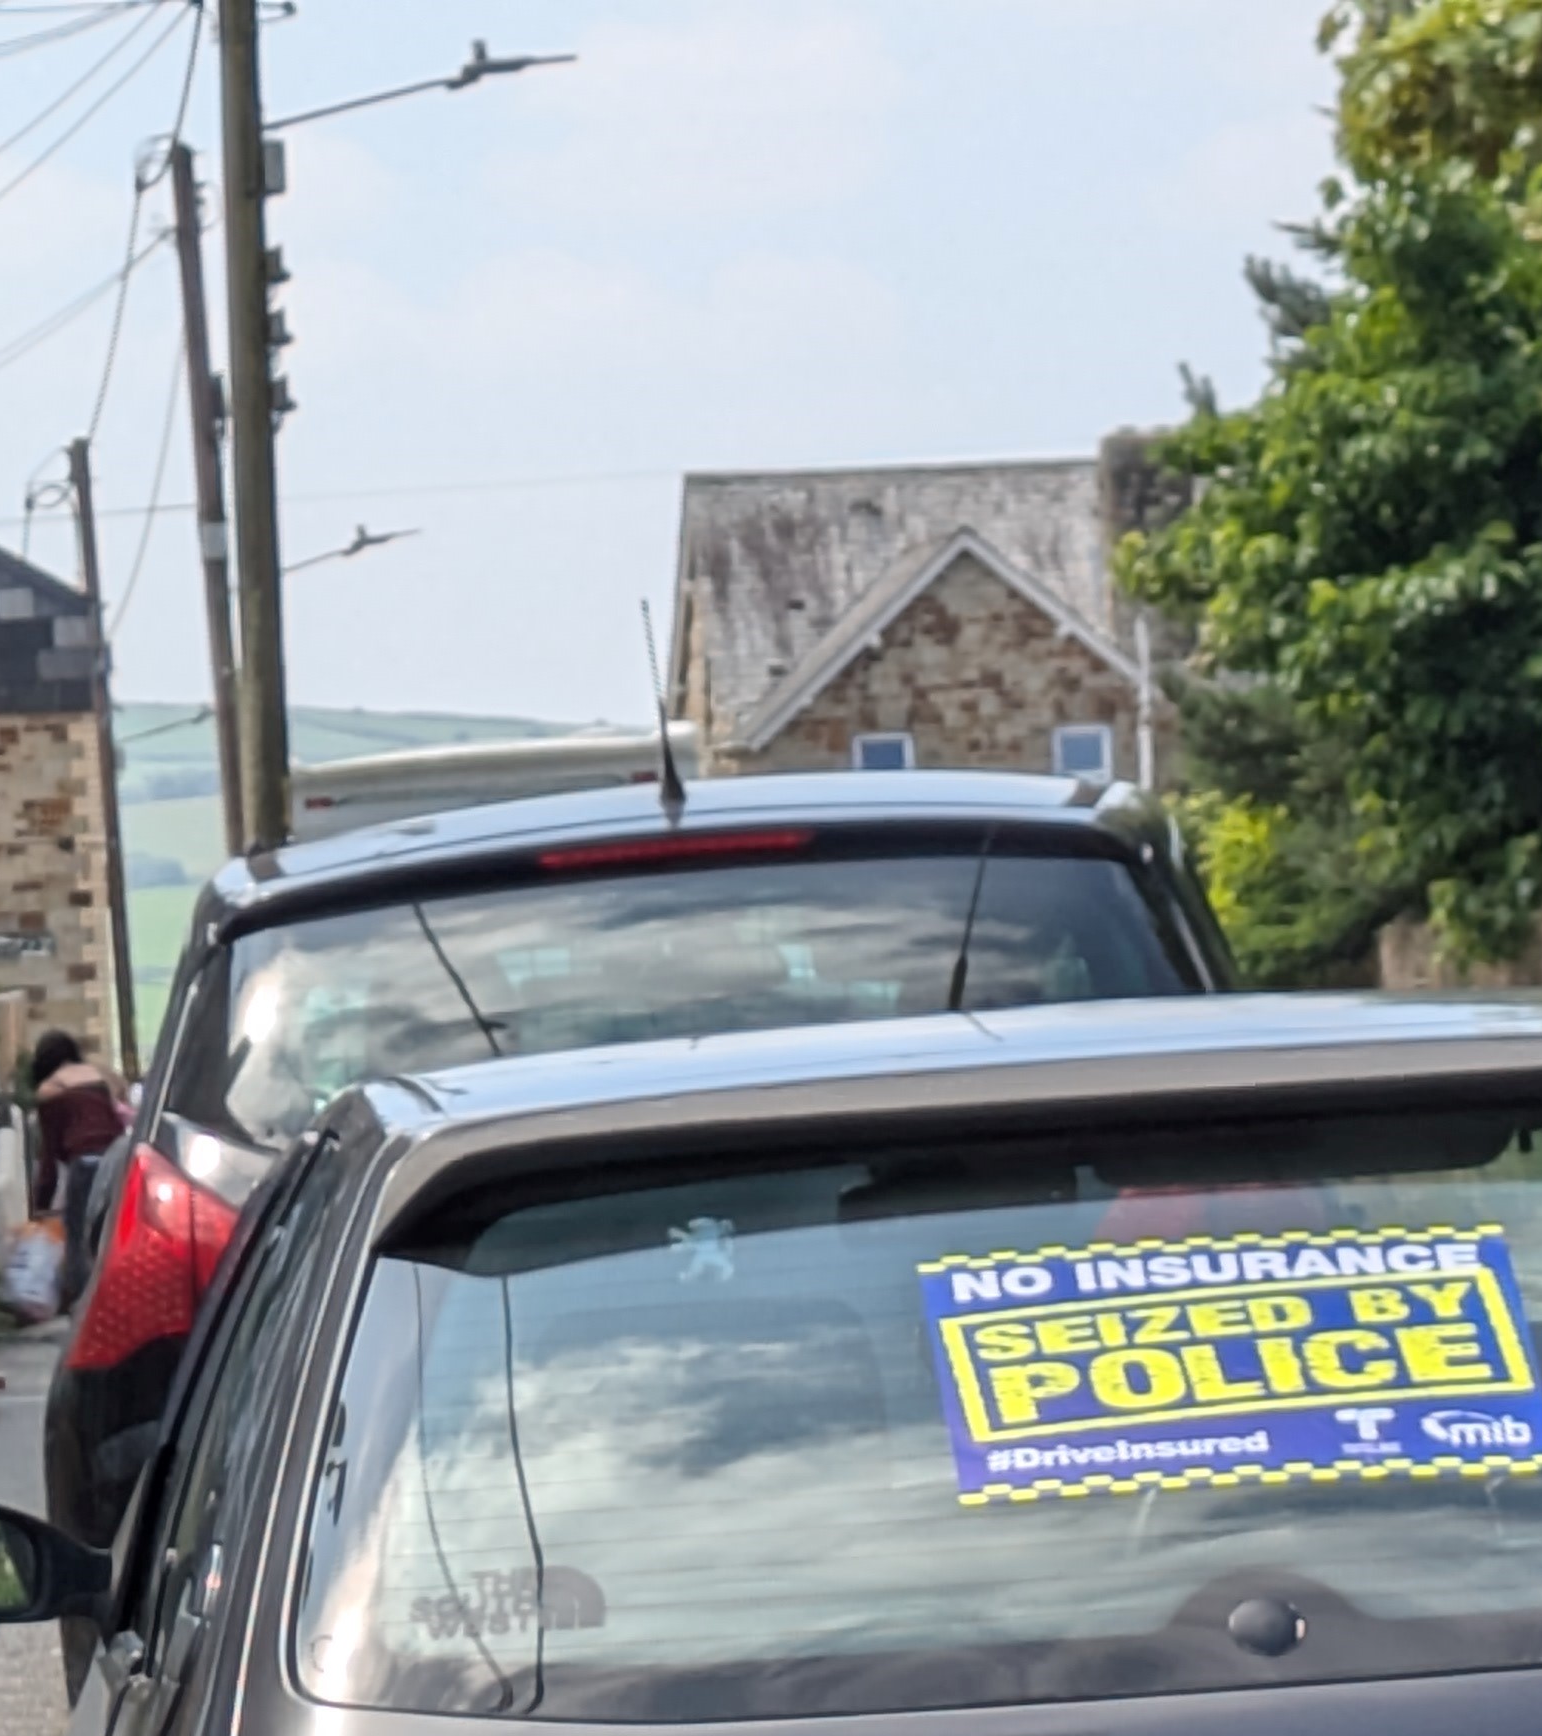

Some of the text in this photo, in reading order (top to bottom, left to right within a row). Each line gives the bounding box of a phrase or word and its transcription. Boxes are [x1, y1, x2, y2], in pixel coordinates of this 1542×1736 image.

[951, 1244, 1483, 1304] NO INSURANCE
[973, 1281, 1472, 1361] SEIZED BY
[988, 1322, 1494, 1425] POLICE
[986, 1429, 1270, 1473] #DriveInsured
[1449, 1414, 1533, 1447] mib
